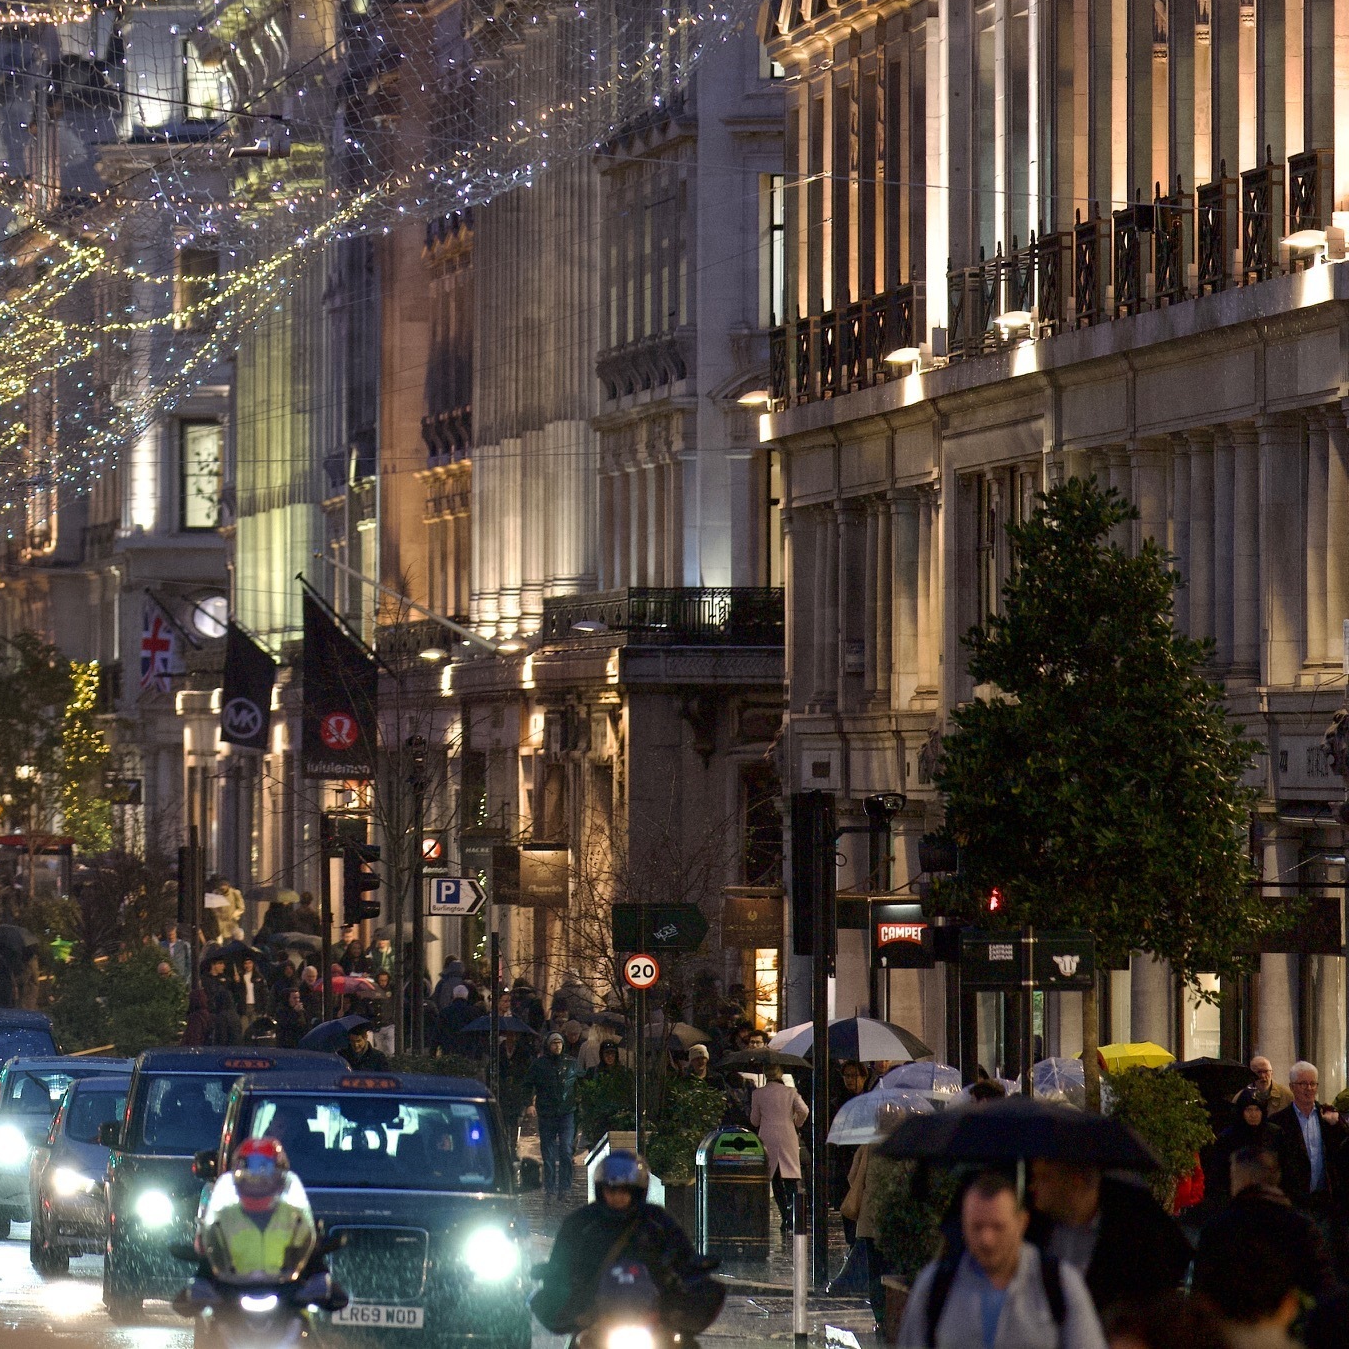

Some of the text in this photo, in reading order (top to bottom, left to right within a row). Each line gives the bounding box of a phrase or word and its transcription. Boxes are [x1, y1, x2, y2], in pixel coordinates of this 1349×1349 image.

[307, 761, 371, 775] lululemon
[441, 881, 456, 902] P
[432, 904, 466, 913] Burlington
[630, 964, 655, 979] 20
[228, 1059, 268, 1068] TAXI
[338, 1306, 381, 1322] LR69
